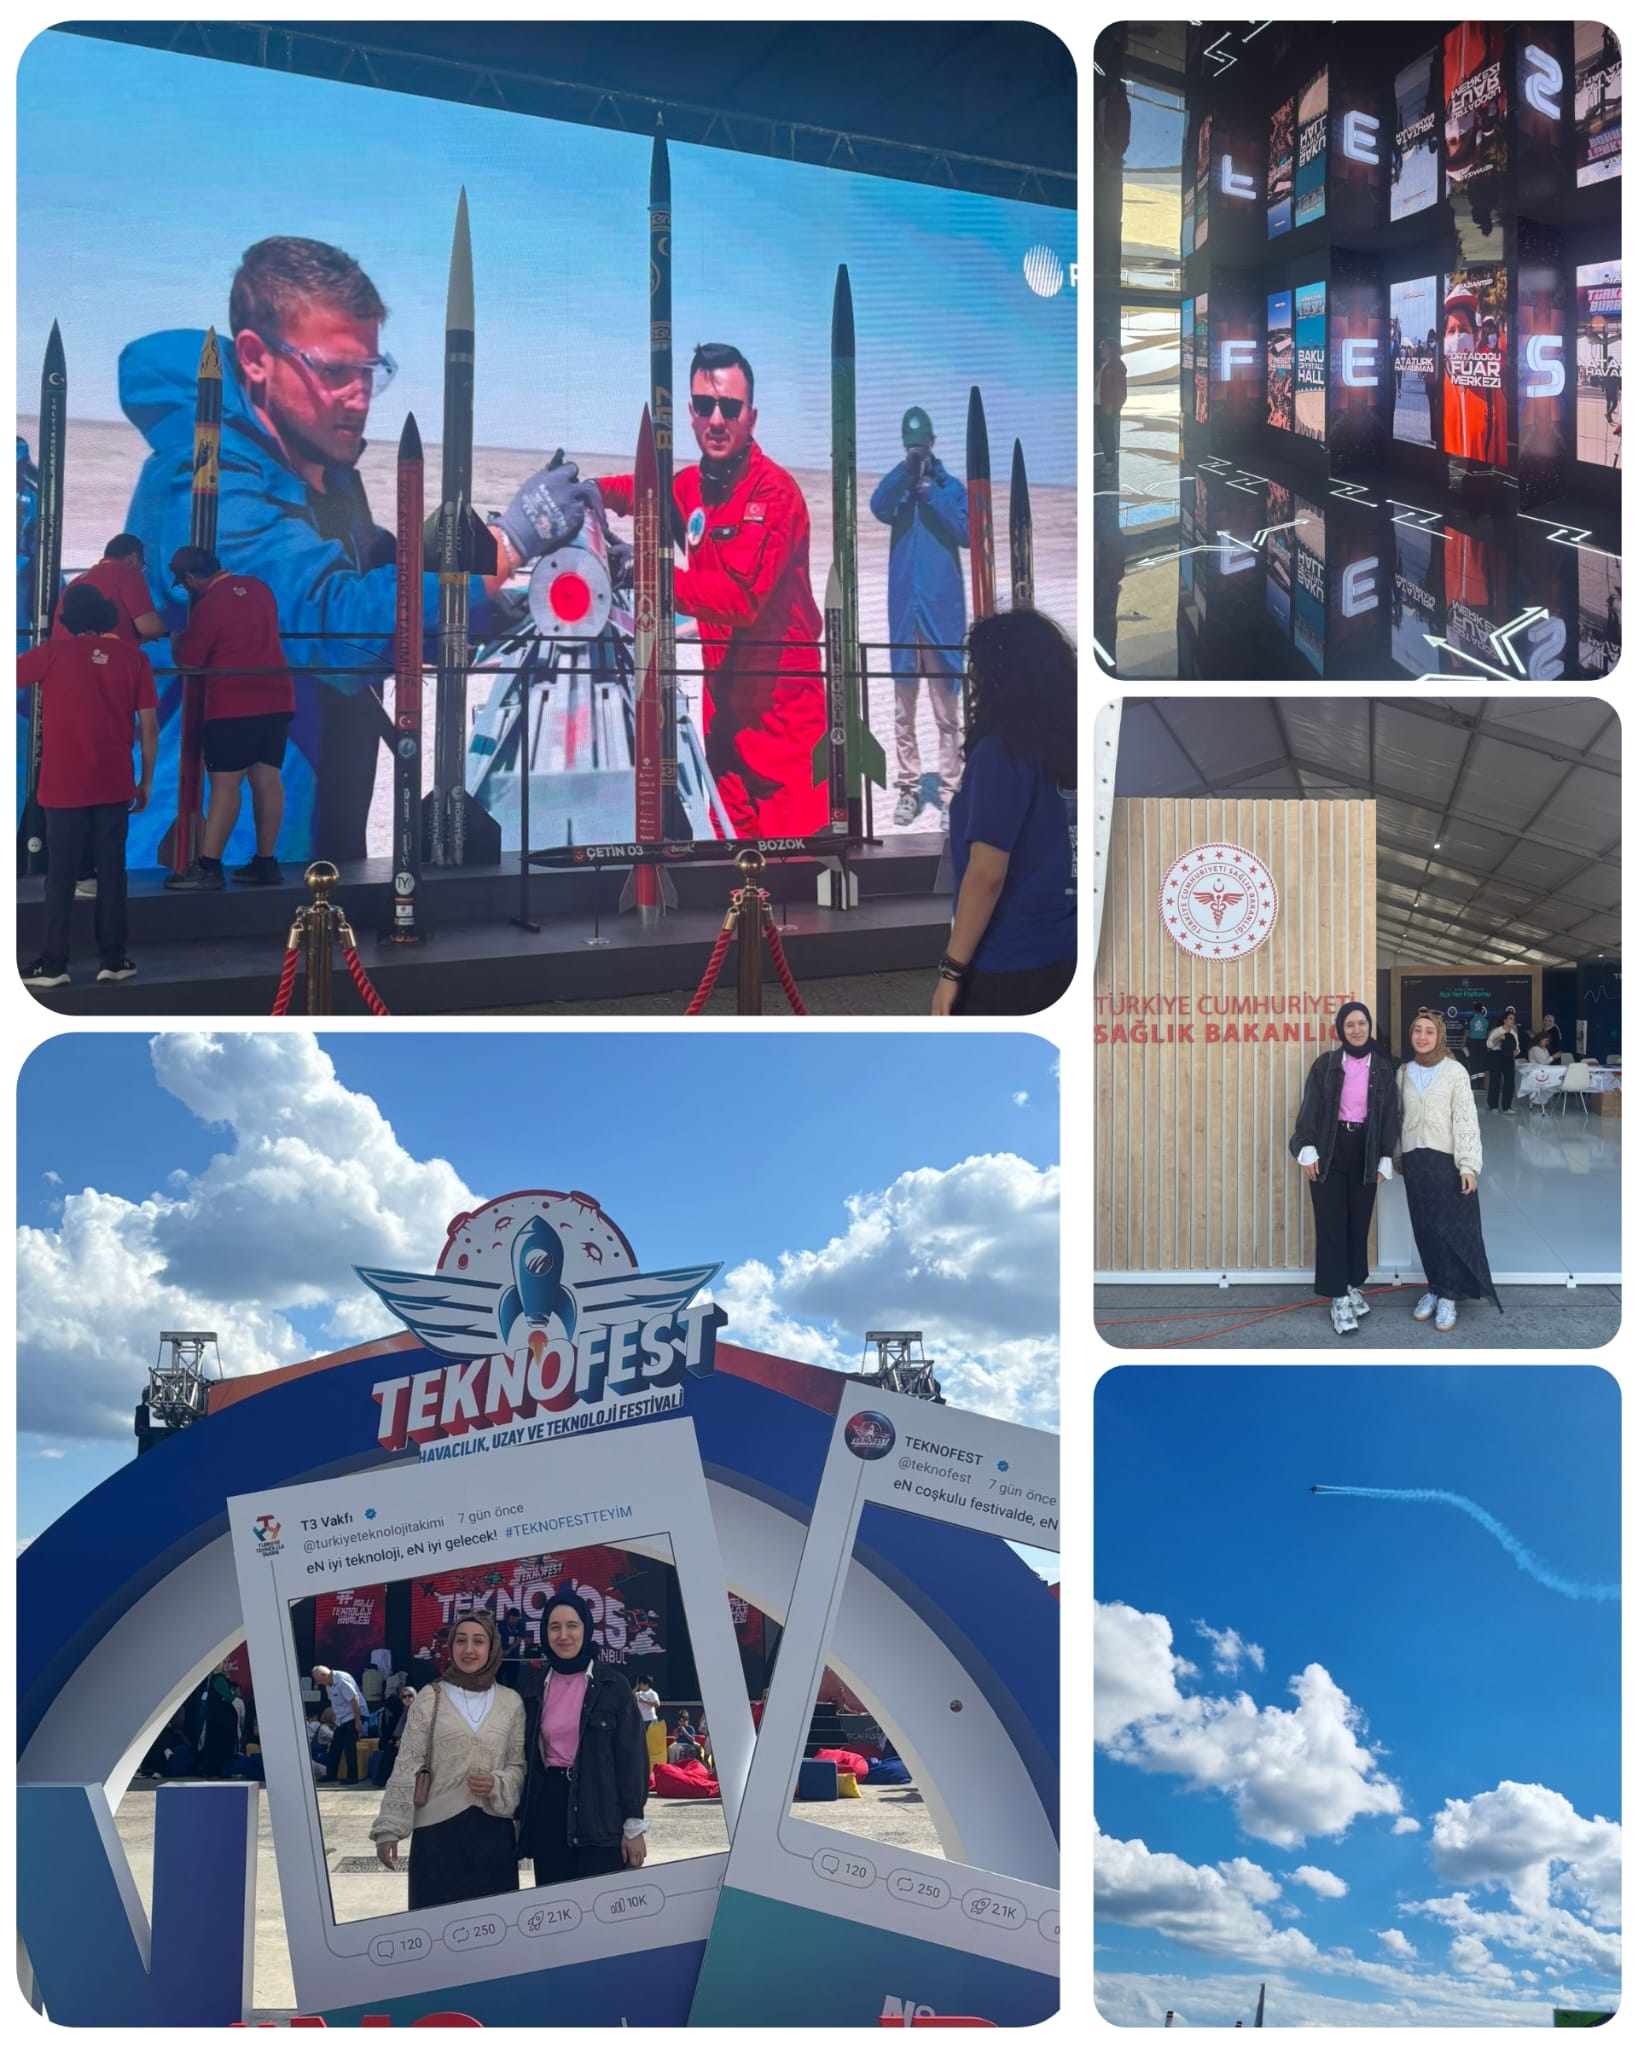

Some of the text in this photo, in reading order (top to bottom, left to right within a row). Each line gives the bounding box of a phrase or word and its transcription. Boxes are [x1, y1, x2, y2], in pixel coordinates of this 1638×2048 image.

[1221, 340, 1256, 381] F
[1298, 350, 1325, 363] BAKU
[1342, 338, 1378, 387] E
[1451, 360, 1501, 377] FUAR
[1526, 334, 1565, 398] S
[1298, 369, 1325, 385] HALL
[586, 845, 644, 860] ÇETİN 03
[758, 838, 806, 851] BOZOK
[1094, 991, 1356, 1016] TÜRKİYE CUMHURİYET
[1094, 1019, 1338, 1044] SAĞLIK BAKANLI
[371, 1302, 728, 1452] TEKNOFEST
[418, 1388, 684, 1463] HAVACILIK, UZAY VE TEKNOLOJİ FESTİVALİ
[904, 1436, 984, 1466] TEKNOFEST
[898, 1456, 1058, 1506] @teknofest 7 gün önce
[893, 1479, 913, 1492] eN
[915, 1484, 967, 1507] coşkulu
[970, 1498, 1037, 1527] festivalde,
[301, 1512, 354, 1532] T3 Vakfı
[303, 1504, 524, 1553] @turkiyeteknolojitakimi 7 gün önce
[306, 1505, 633, 1574] eN iyi teknoloji, eN iyi gelecek! #TEKNOFESTTEYİM
[845, 1863, 867, 1878] 120
[626, 1895, 648, 1909] 10K
[917, 1883, 941, 1899] 250
[474, 1923, 496, 1938] 250
[400, 1936, 423, 1951] 120
